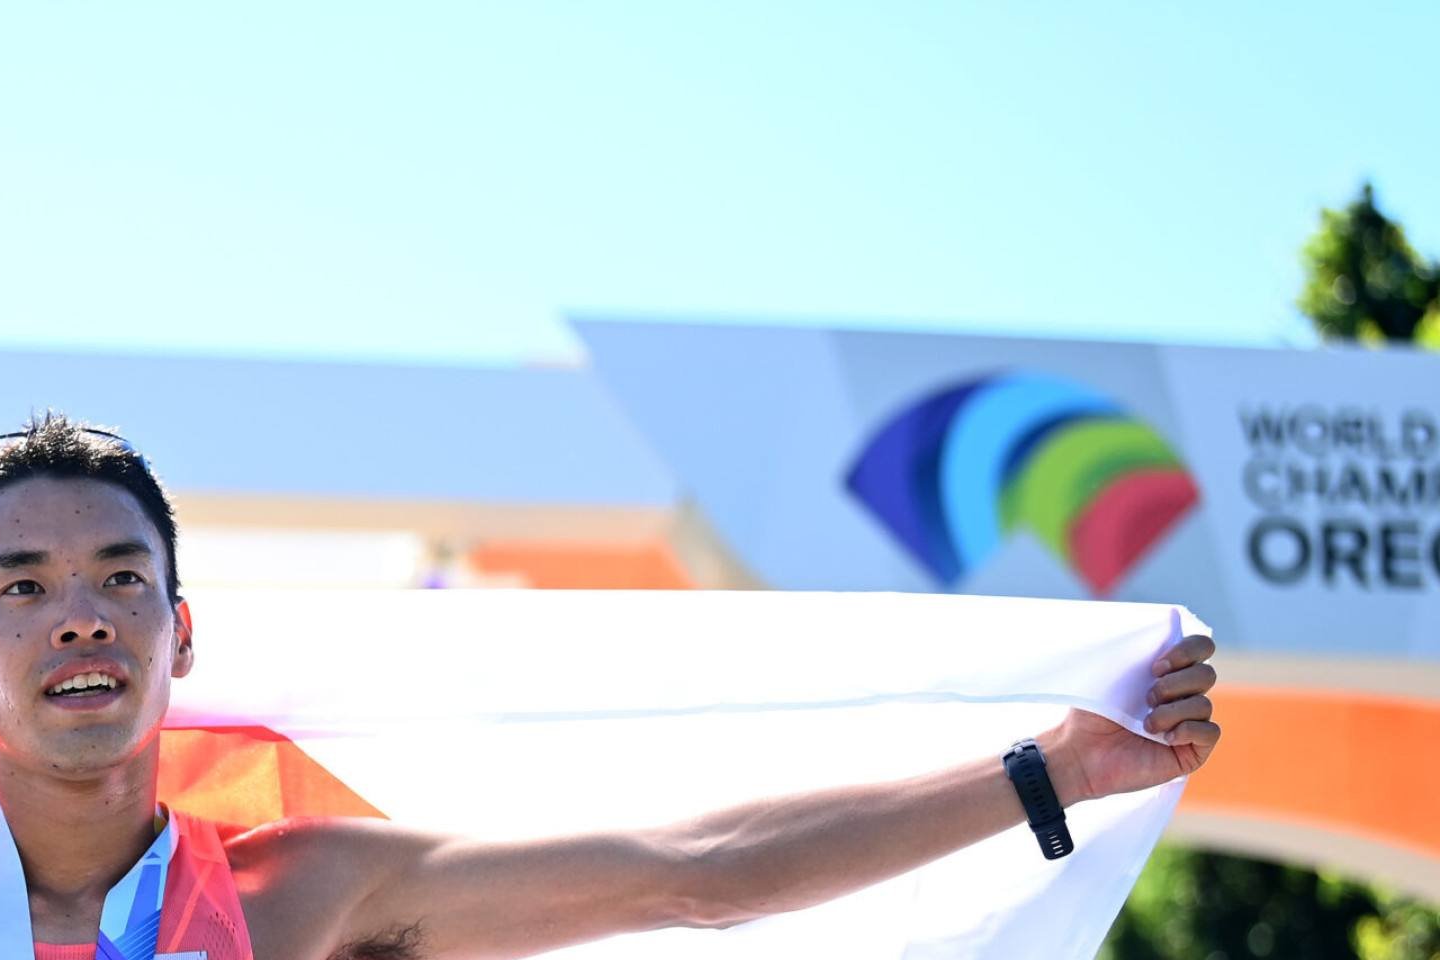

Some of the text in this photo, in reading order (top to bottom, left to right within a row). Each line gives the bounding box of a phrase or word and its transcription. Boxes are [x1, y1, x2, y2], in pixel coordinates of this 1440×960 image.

[1238, 402, 1437, 462] WORLD
[1243, 456, 1440, 512] CHAM
[1245, 515, 1440, 590] ORE
